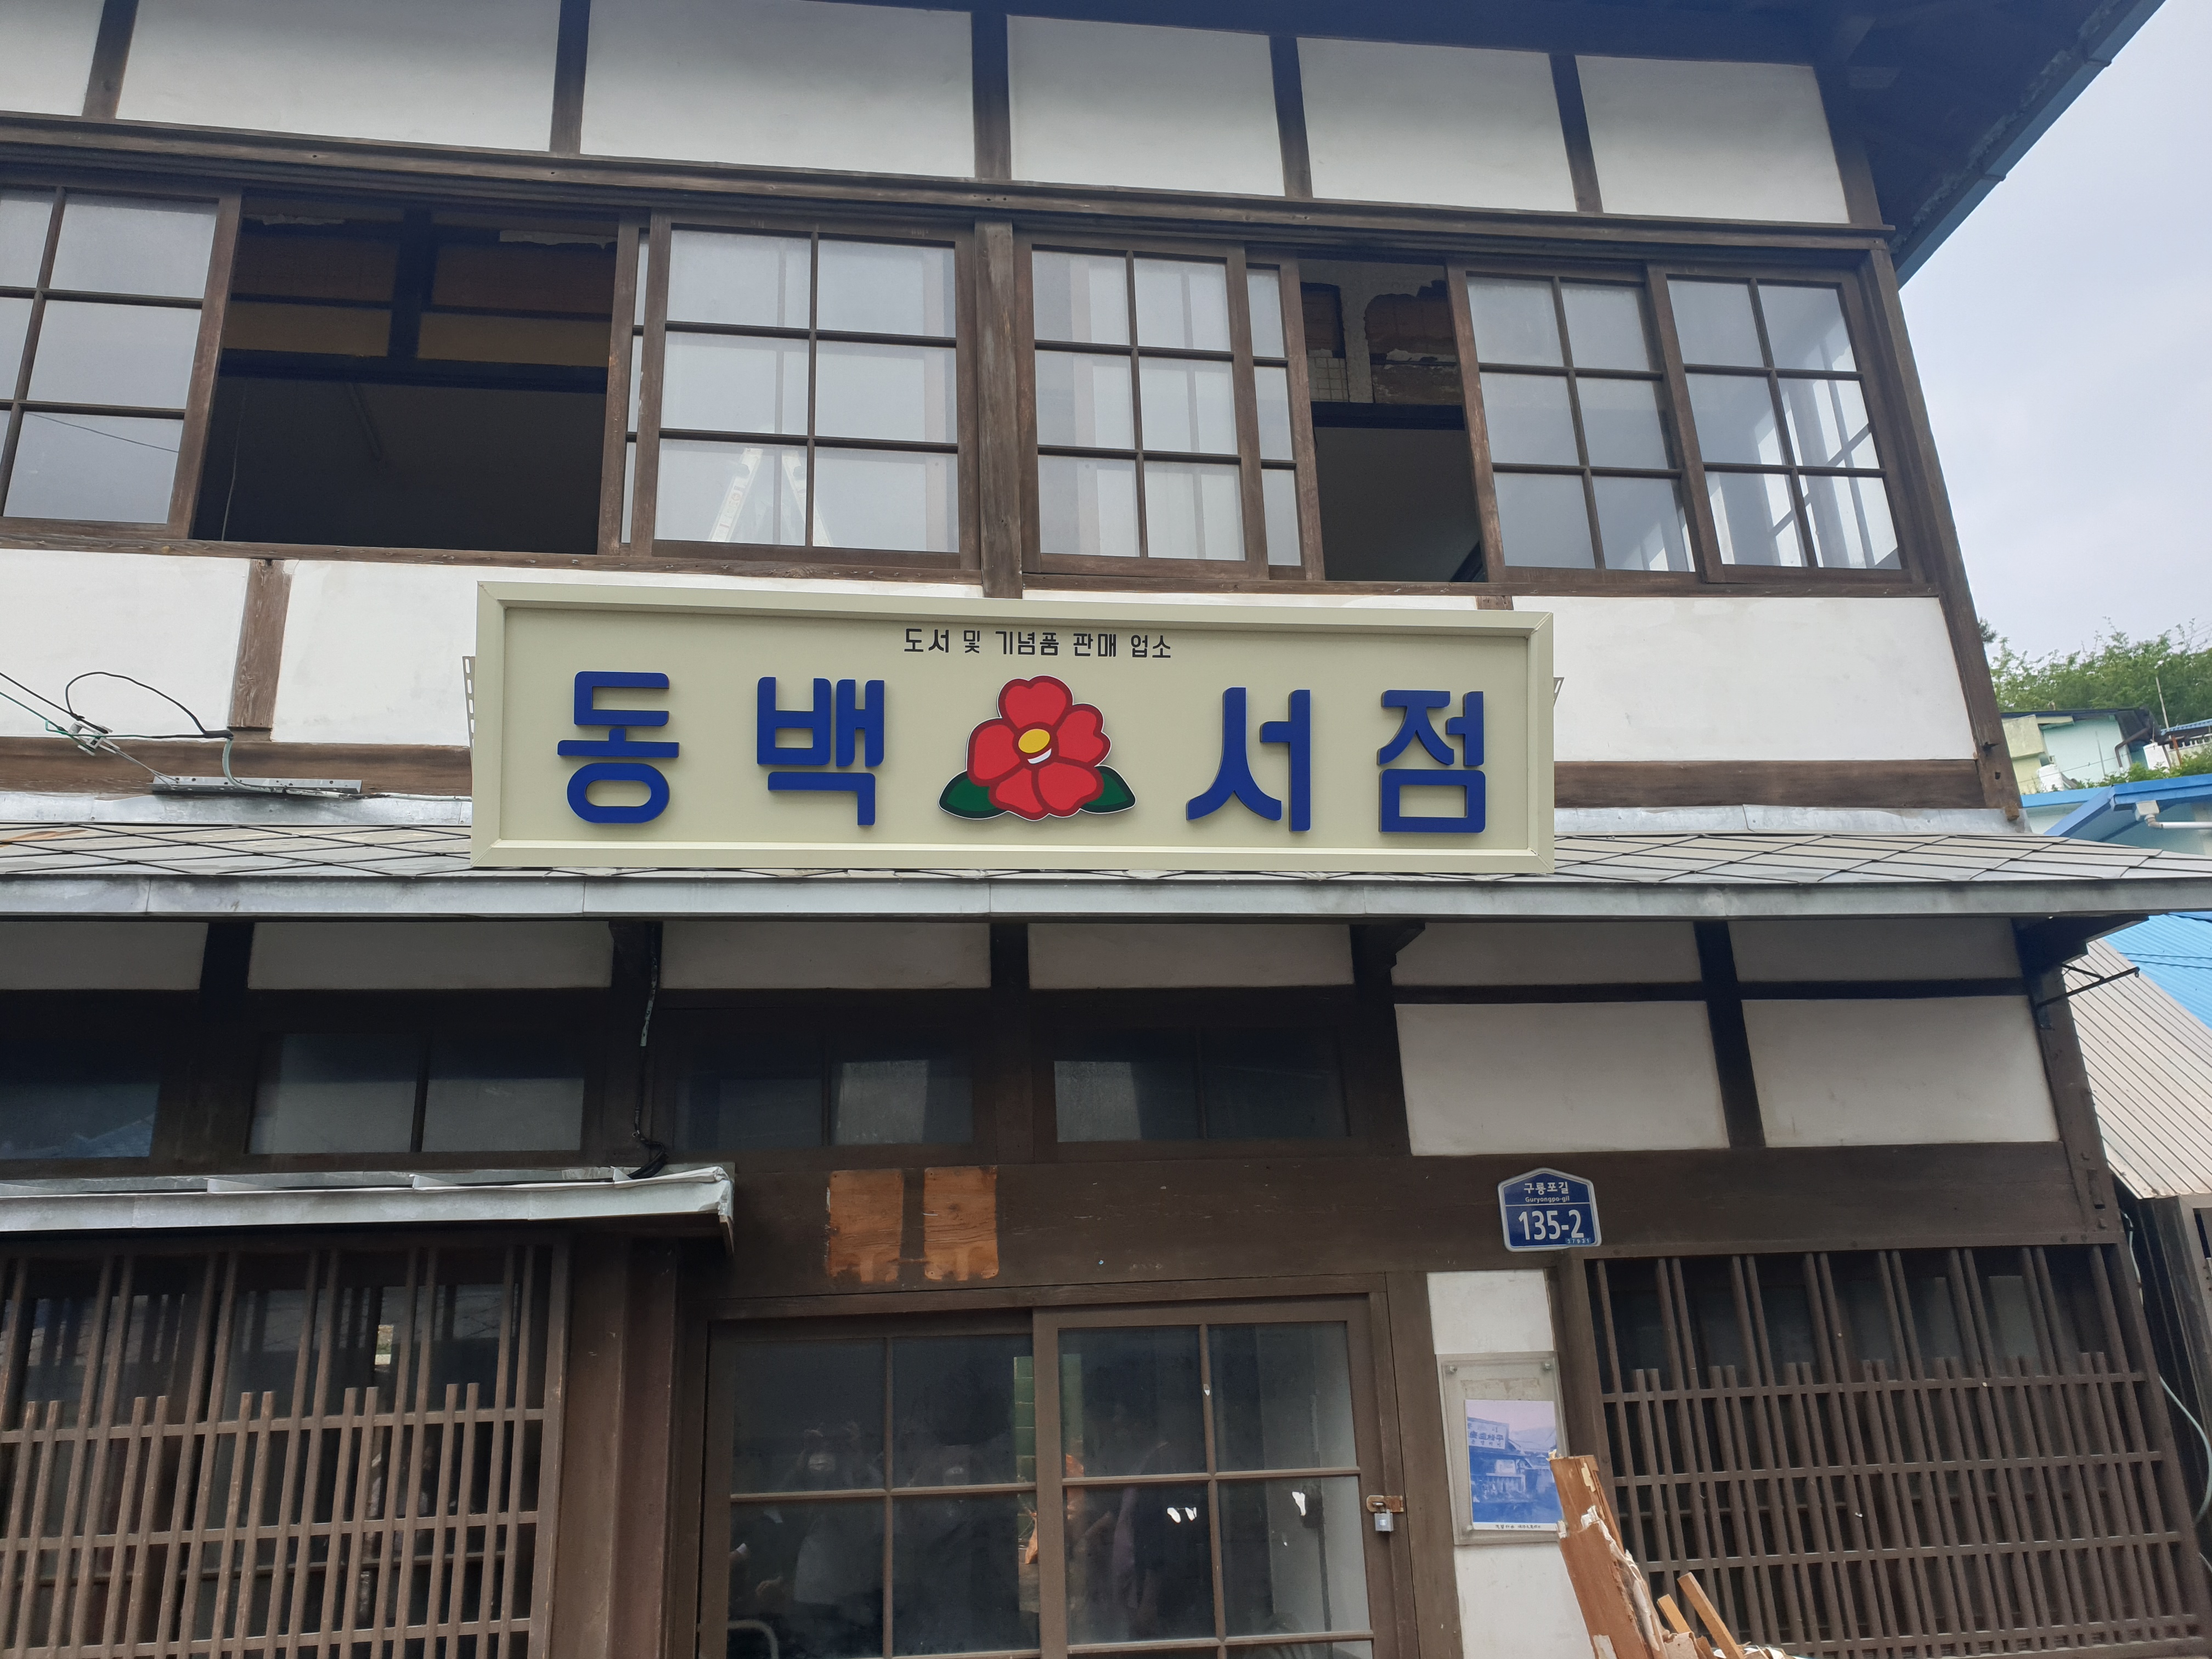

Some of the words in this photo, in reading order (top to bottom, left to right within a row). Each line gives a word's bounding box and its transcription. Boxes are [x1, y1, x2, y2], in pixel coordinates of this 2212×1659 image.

[904, 628, 949, 653] 도서
[963, 630, 981, 654] 및
[995, 630, 1059, 656] 기념품
[1073, 633, 1117, 657] 판매
[1130, 634, 1171, 658] 업소
[557, 670, 884, 826] 동백
[1185, 686, 1486, 833] 서점
[1523, 1181, 1569, 1195] 구룡포길
[1518, 1209, 1584, 1240] 135-2
